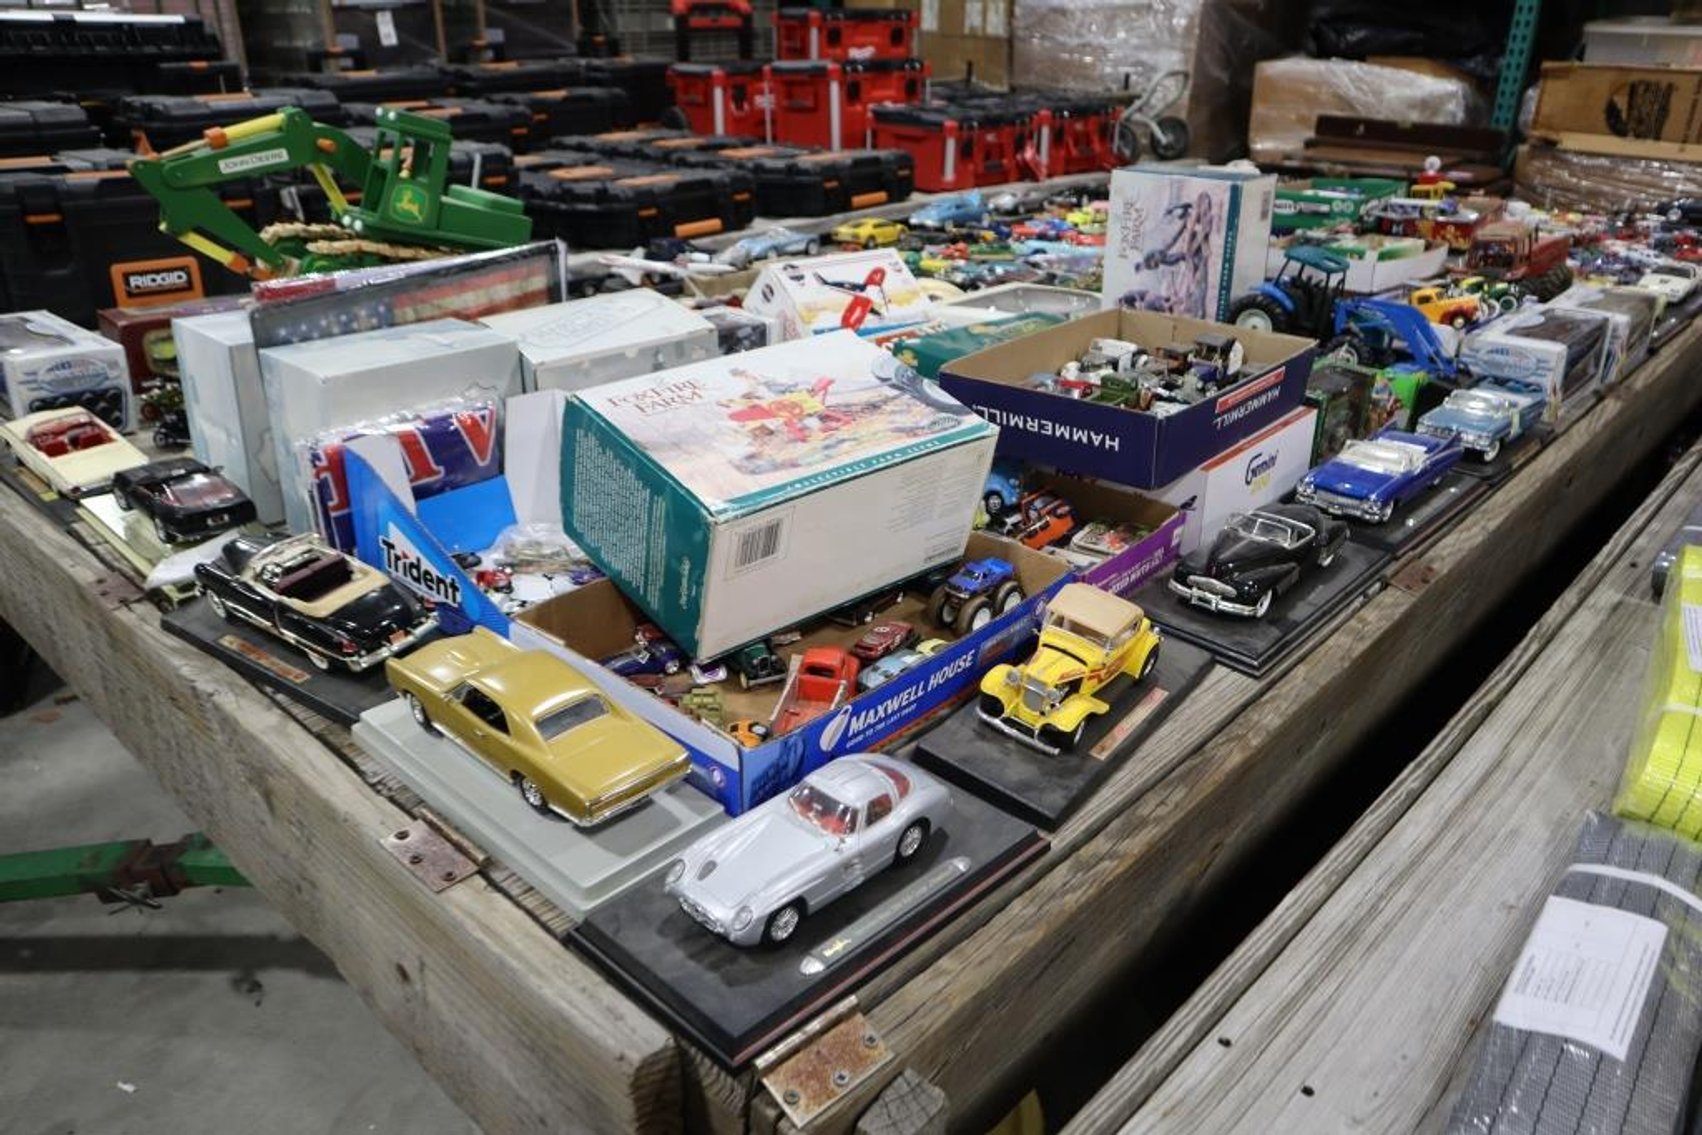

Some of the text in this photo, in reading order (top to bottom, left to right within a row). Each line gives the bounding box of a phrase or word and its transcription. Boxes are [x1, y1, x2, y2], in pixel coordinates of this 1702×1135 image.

[129, 269, 188, 289] RIDGID
[973, 404, 1121, 452] HAMMERMILL
[380, 537, 460, 605] Trident
[848, 649, 976, 737] MAXWELL HOUSE
